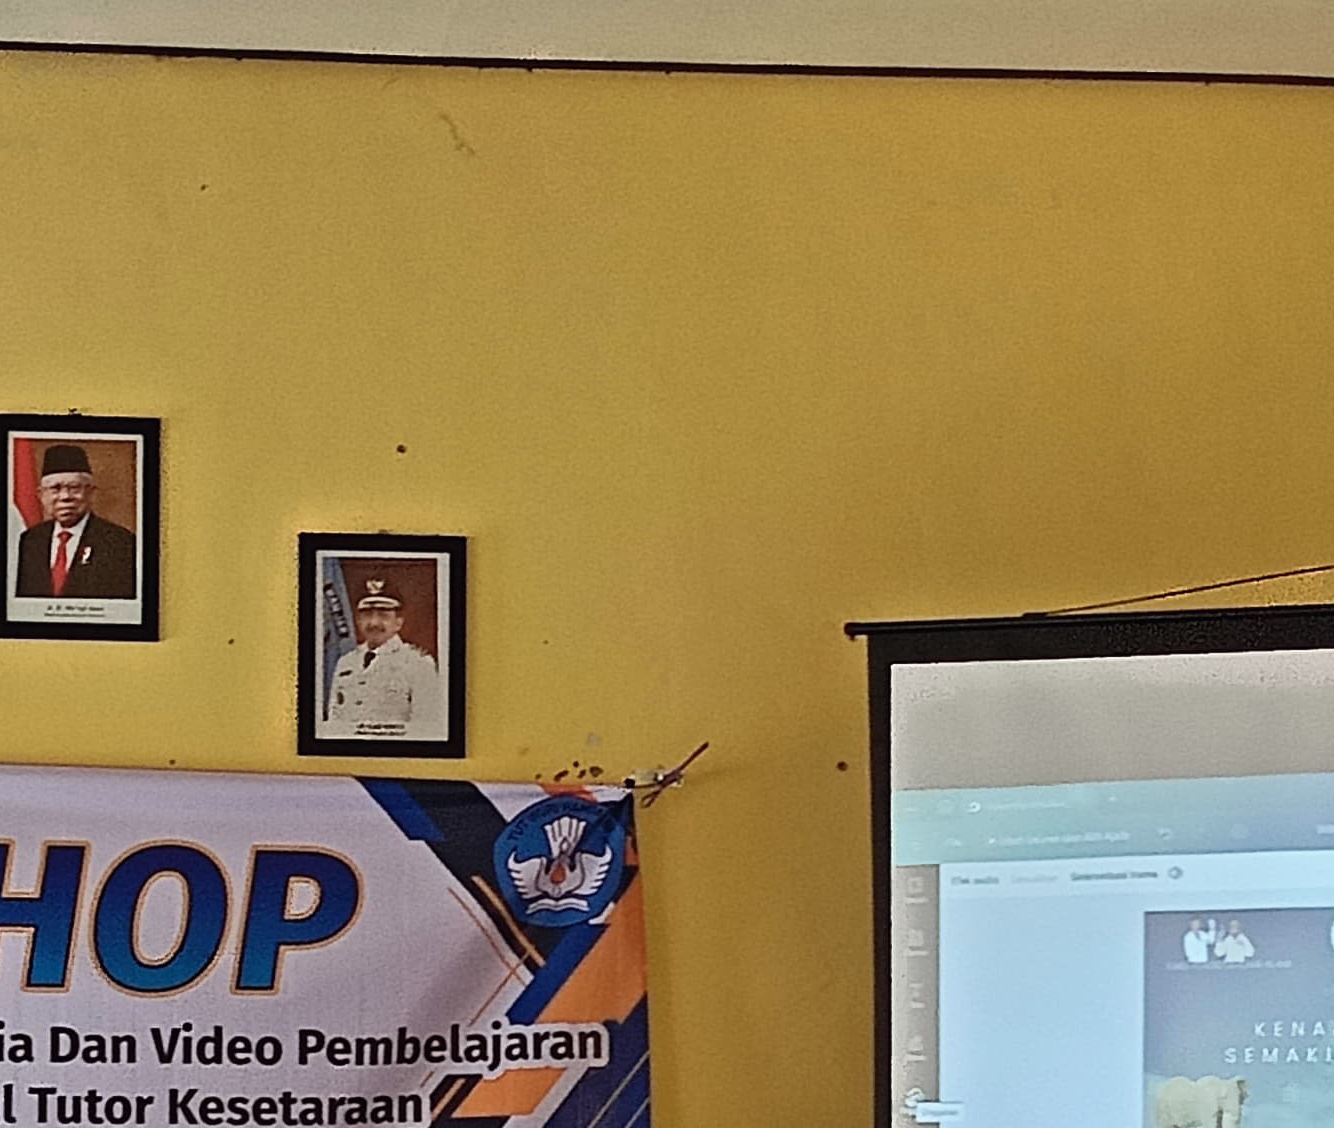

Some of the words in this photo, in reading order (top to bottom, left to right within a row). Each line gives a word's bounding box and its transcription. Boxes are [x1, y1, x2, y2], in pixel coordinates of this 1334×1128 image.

[49, 1025, 137, 1064] Dan
[150, 1021, 283, 1067] Video
[298, 1024, 604, 1076] Pembelajaran
[27, 1085, 155, 1125] Tutor
[168, 1087, 424, 1127] Kesetaraan
